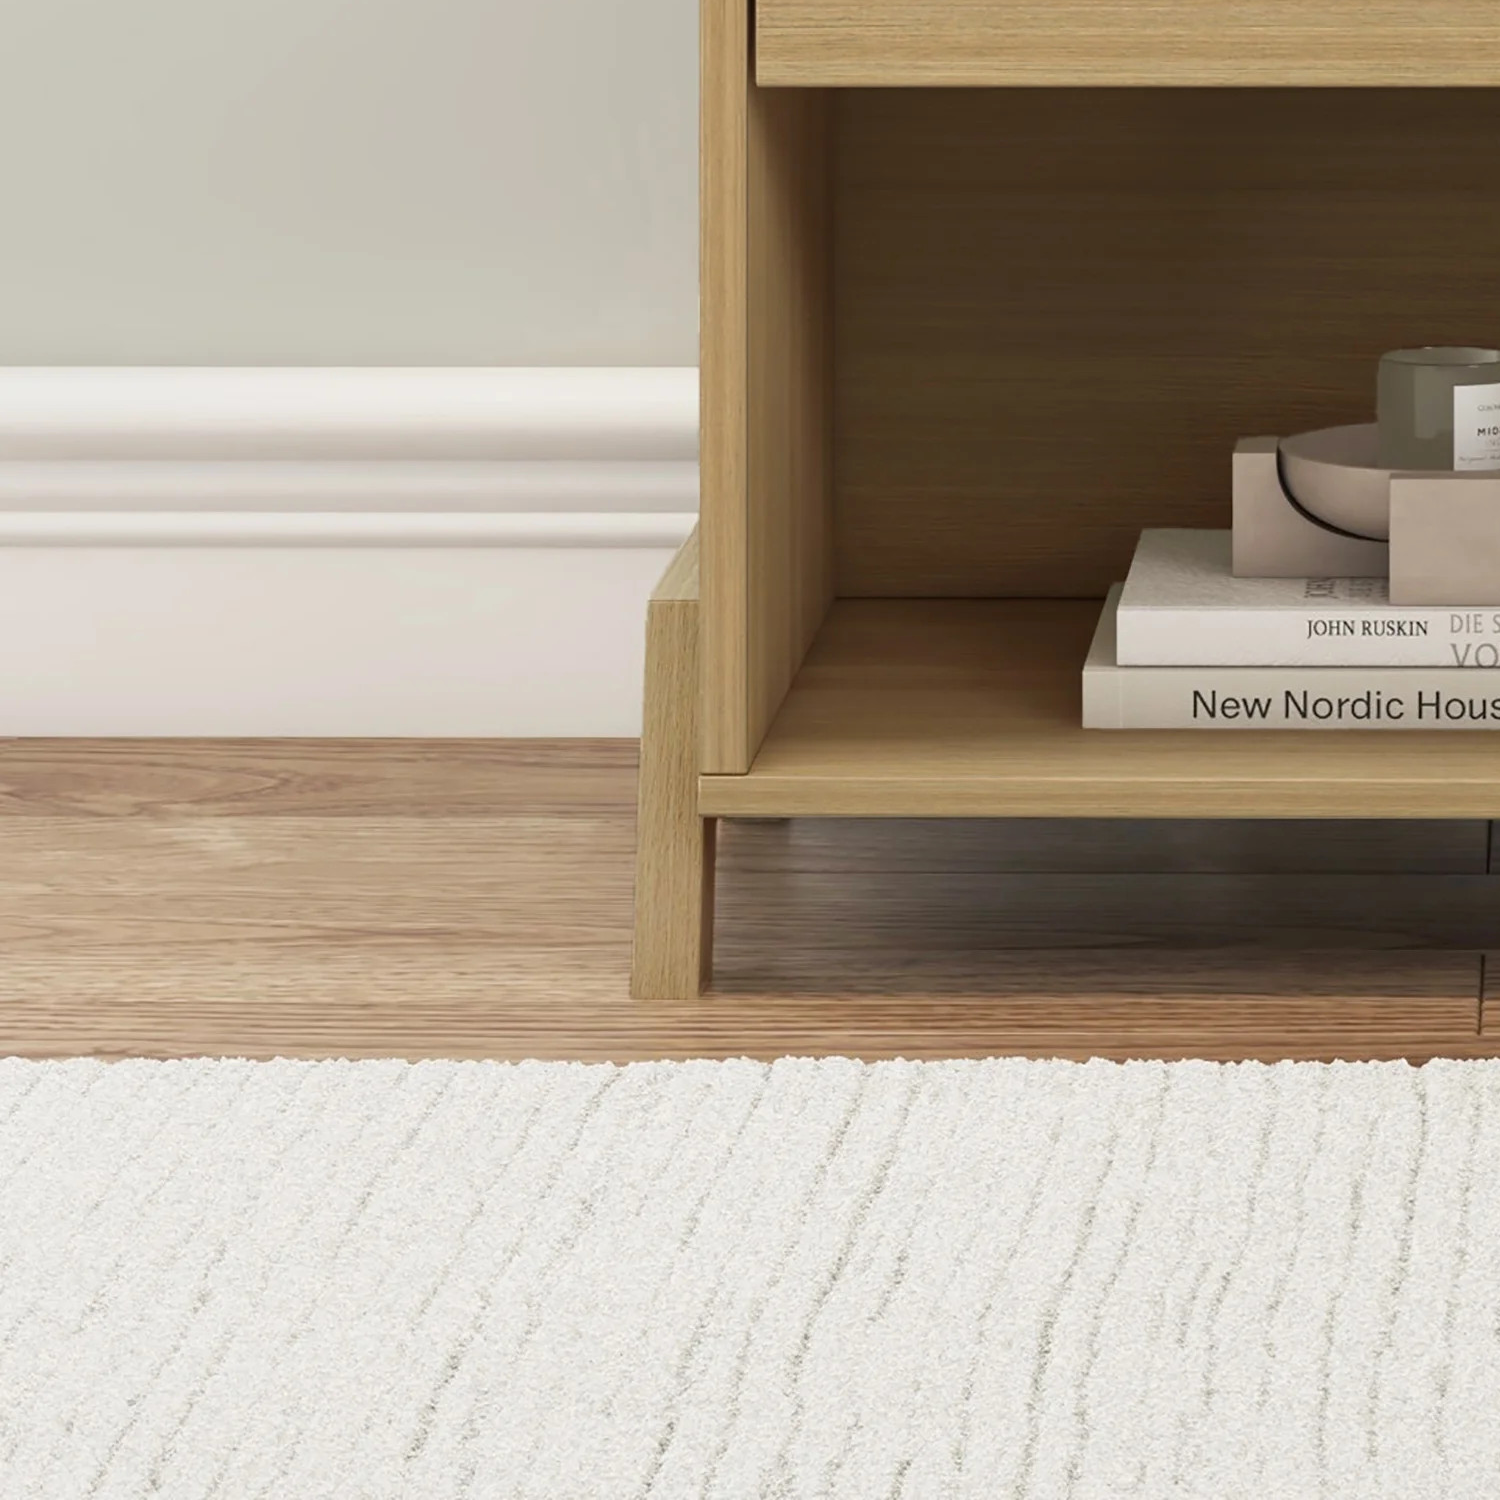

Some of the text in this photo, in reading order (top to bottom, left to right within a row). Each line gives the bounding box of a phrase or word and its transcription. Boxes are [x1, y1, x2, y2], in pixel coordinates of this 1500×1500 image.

[1307, 619, 1428, 639] JOHN RUSKIN
[1450, 614, 1484, 633] DIE
[1192, 690, 1272, 720] New
[1284, 690, 1405, 720] Nordic
